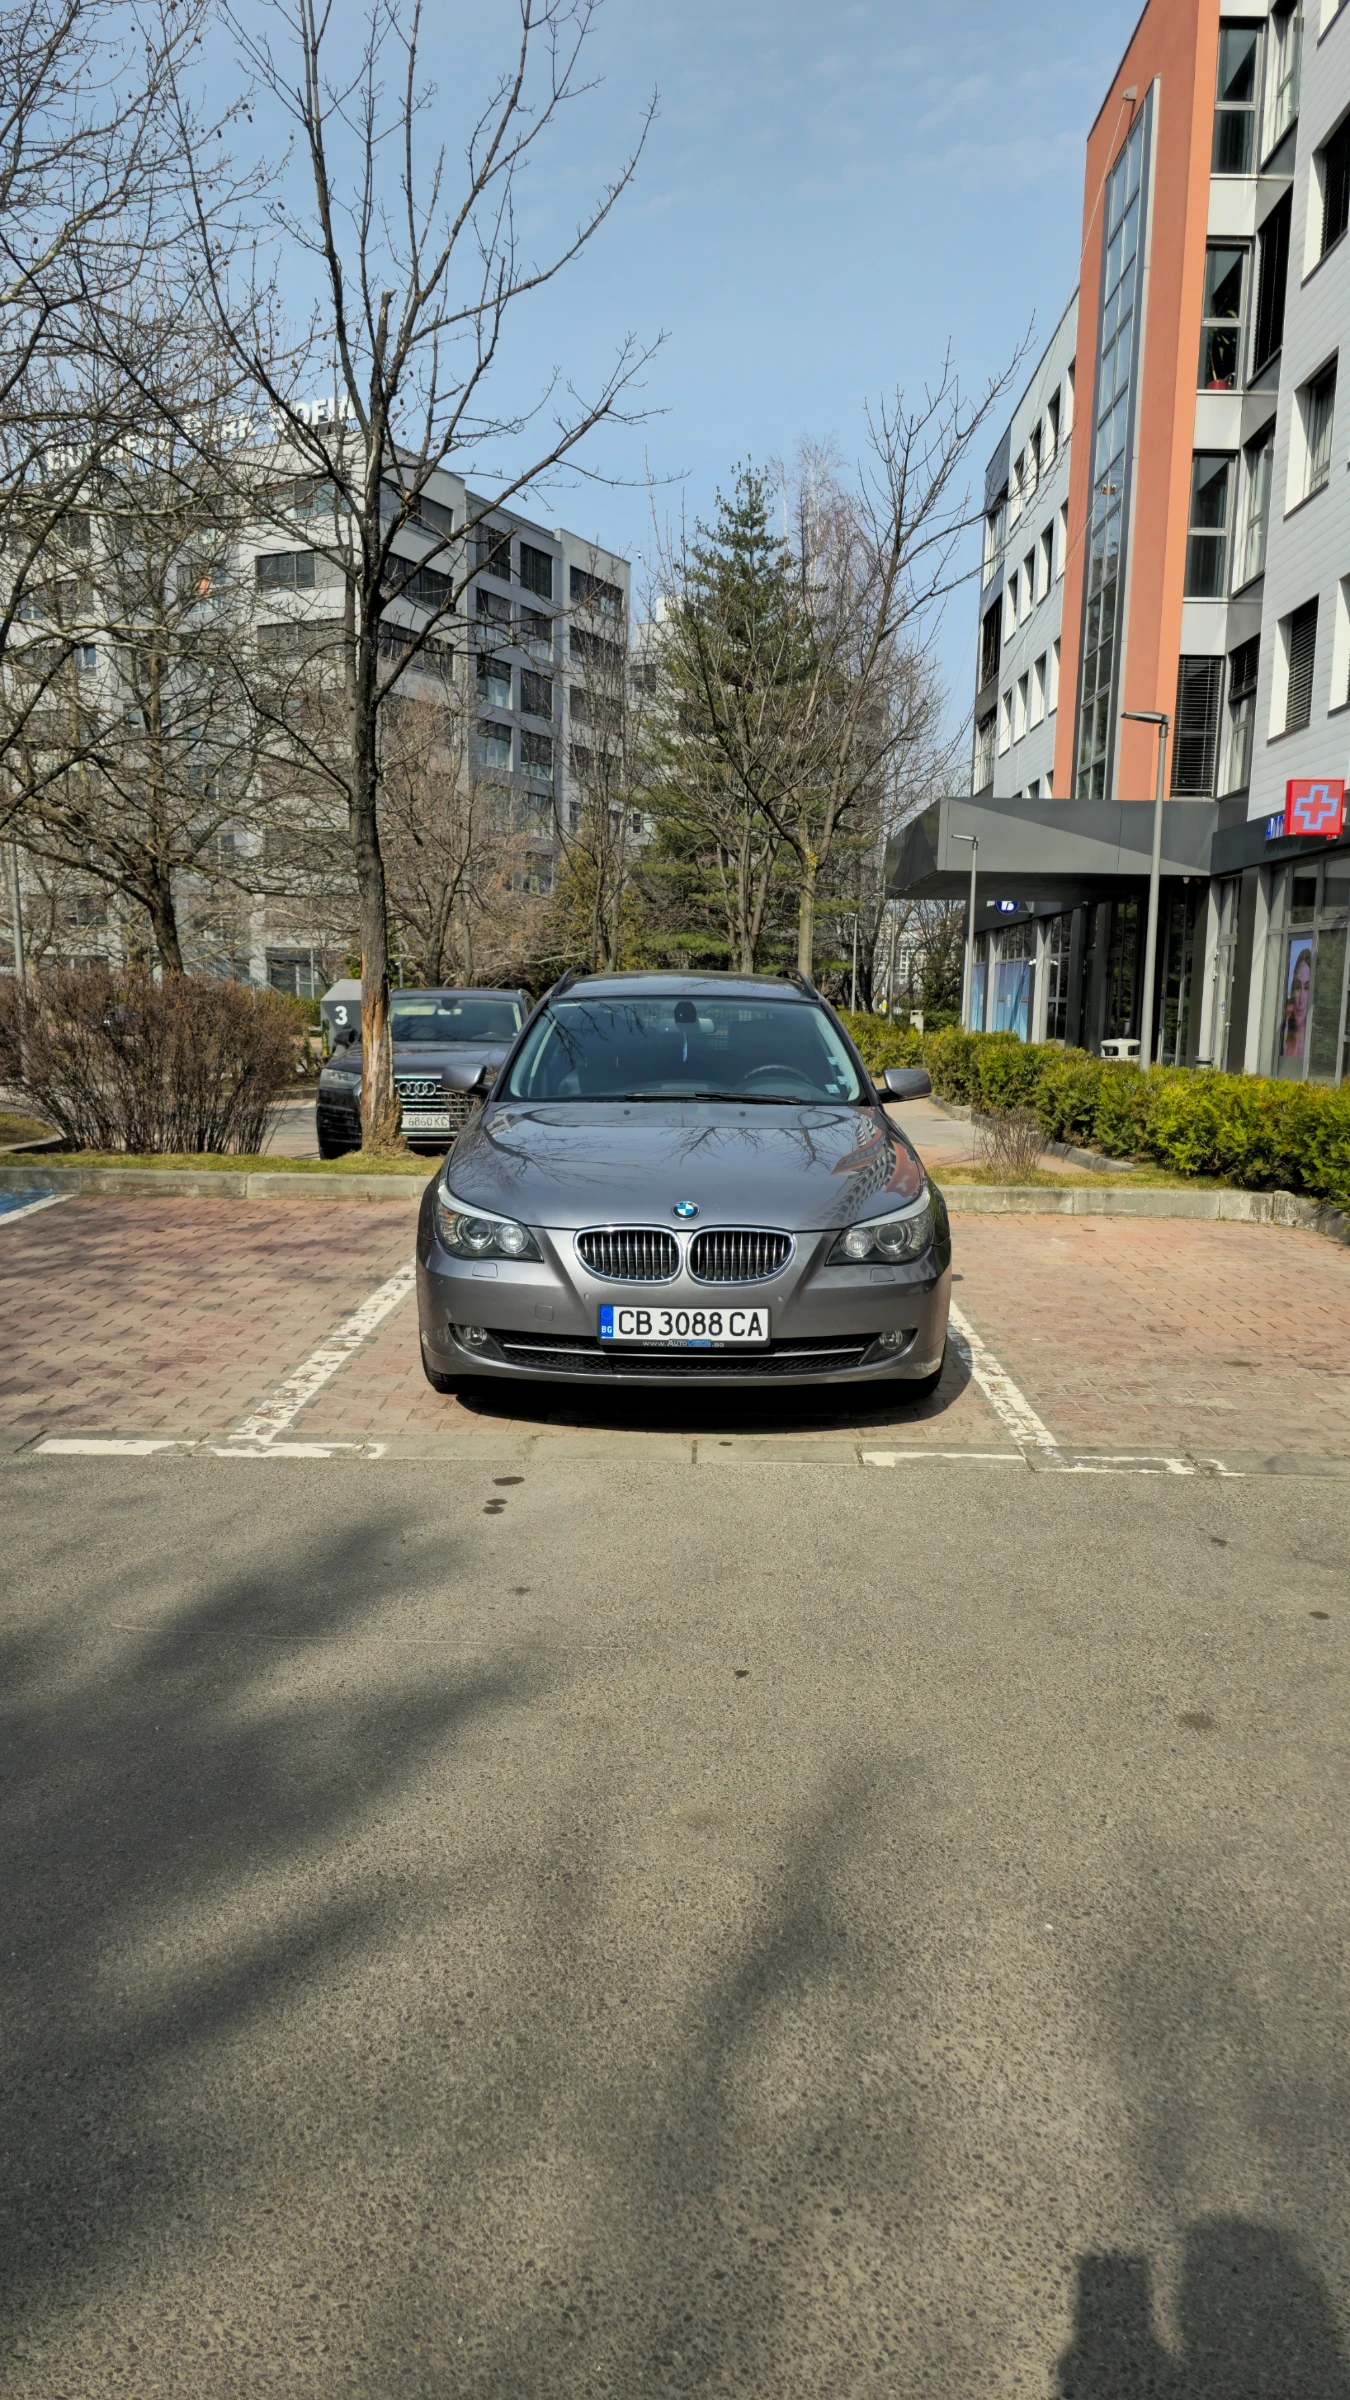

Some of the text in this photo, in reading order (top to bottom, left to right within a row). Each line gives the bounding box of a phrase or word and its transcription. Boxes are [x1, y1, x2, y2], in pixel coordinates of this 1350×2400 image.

[268, 394, 357, 435] SOFIA
[335, 1005, 348, 1025] 3
[408, 1117, 433, 1127] 6860
[601, 1325, 613, 1334] BG
[618, 1310, 763, 1337] CB 3088 CA
